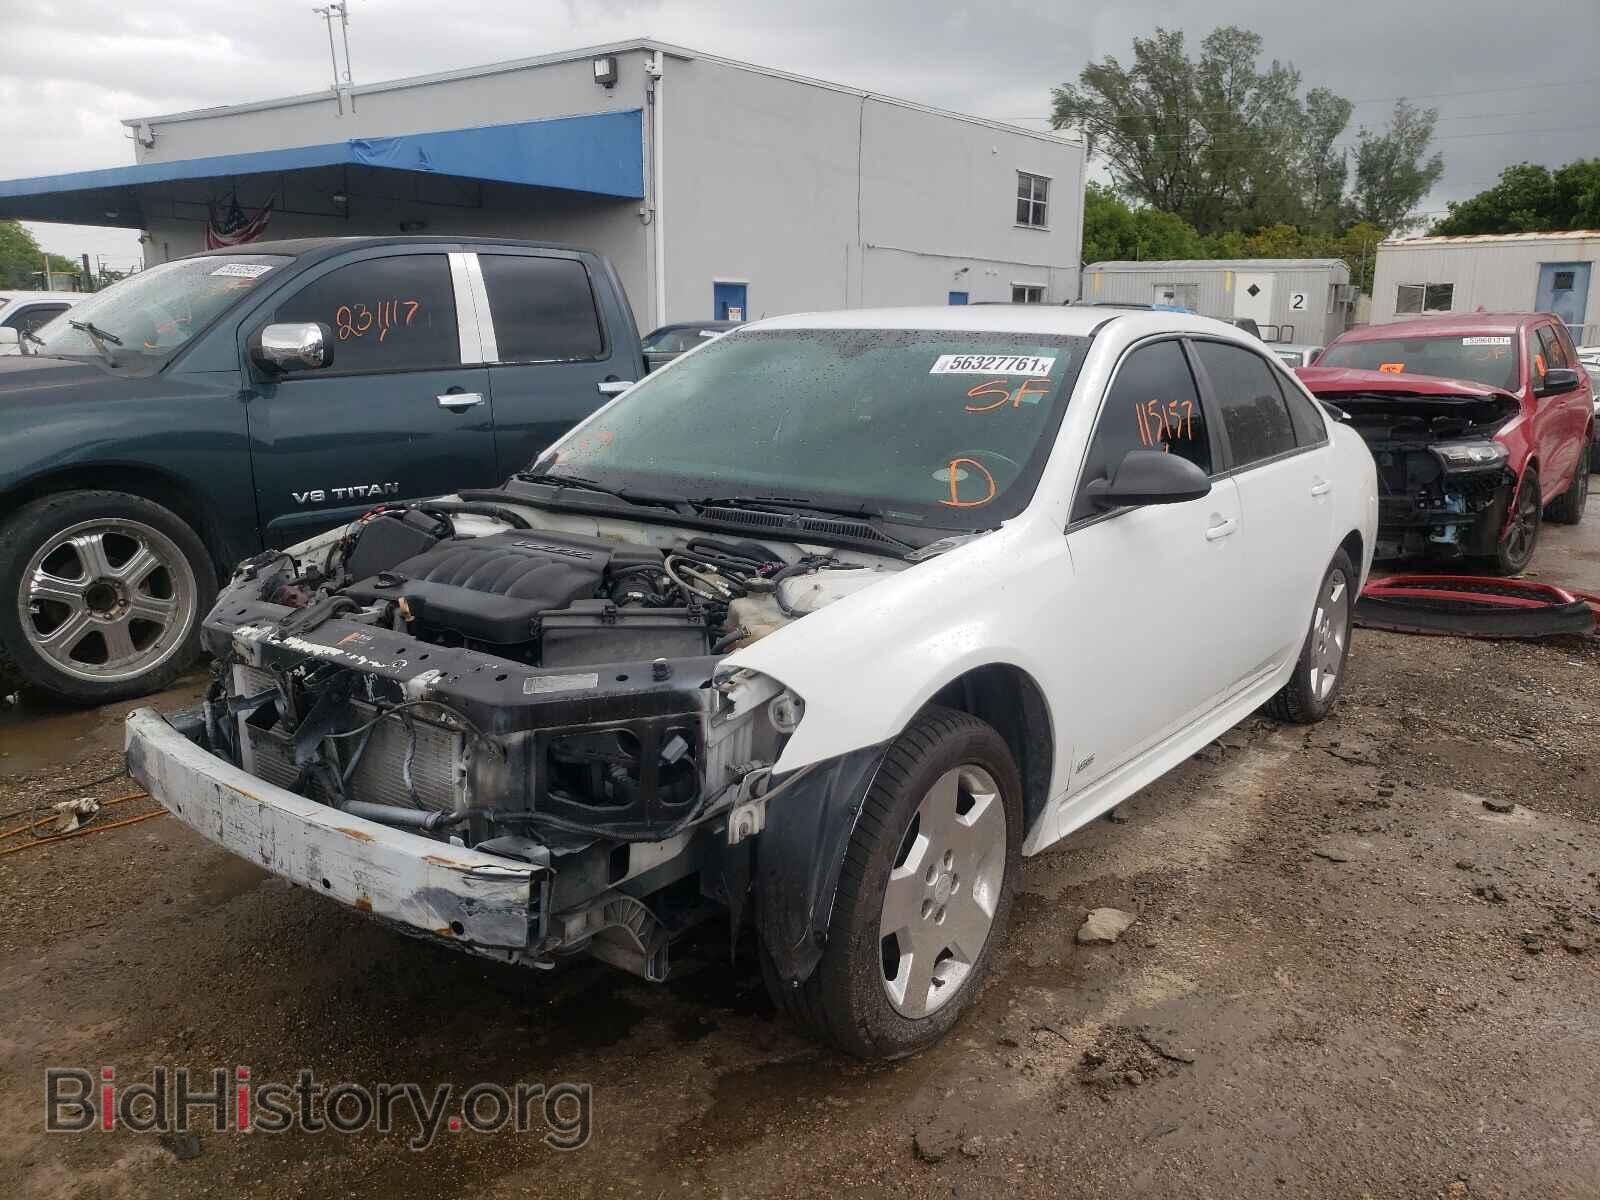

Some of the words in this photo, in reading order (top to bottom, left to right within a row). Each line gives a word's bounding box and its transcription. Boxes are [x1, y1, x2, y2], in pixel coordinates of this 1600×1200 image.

[1293, 294, 1304, 309] 2
[965, 378, 1052, 412] SF
[291, 489, 326, 504] V8
[331, 482, 399, 500] TITAN
[937, 458, 996, 508] D
